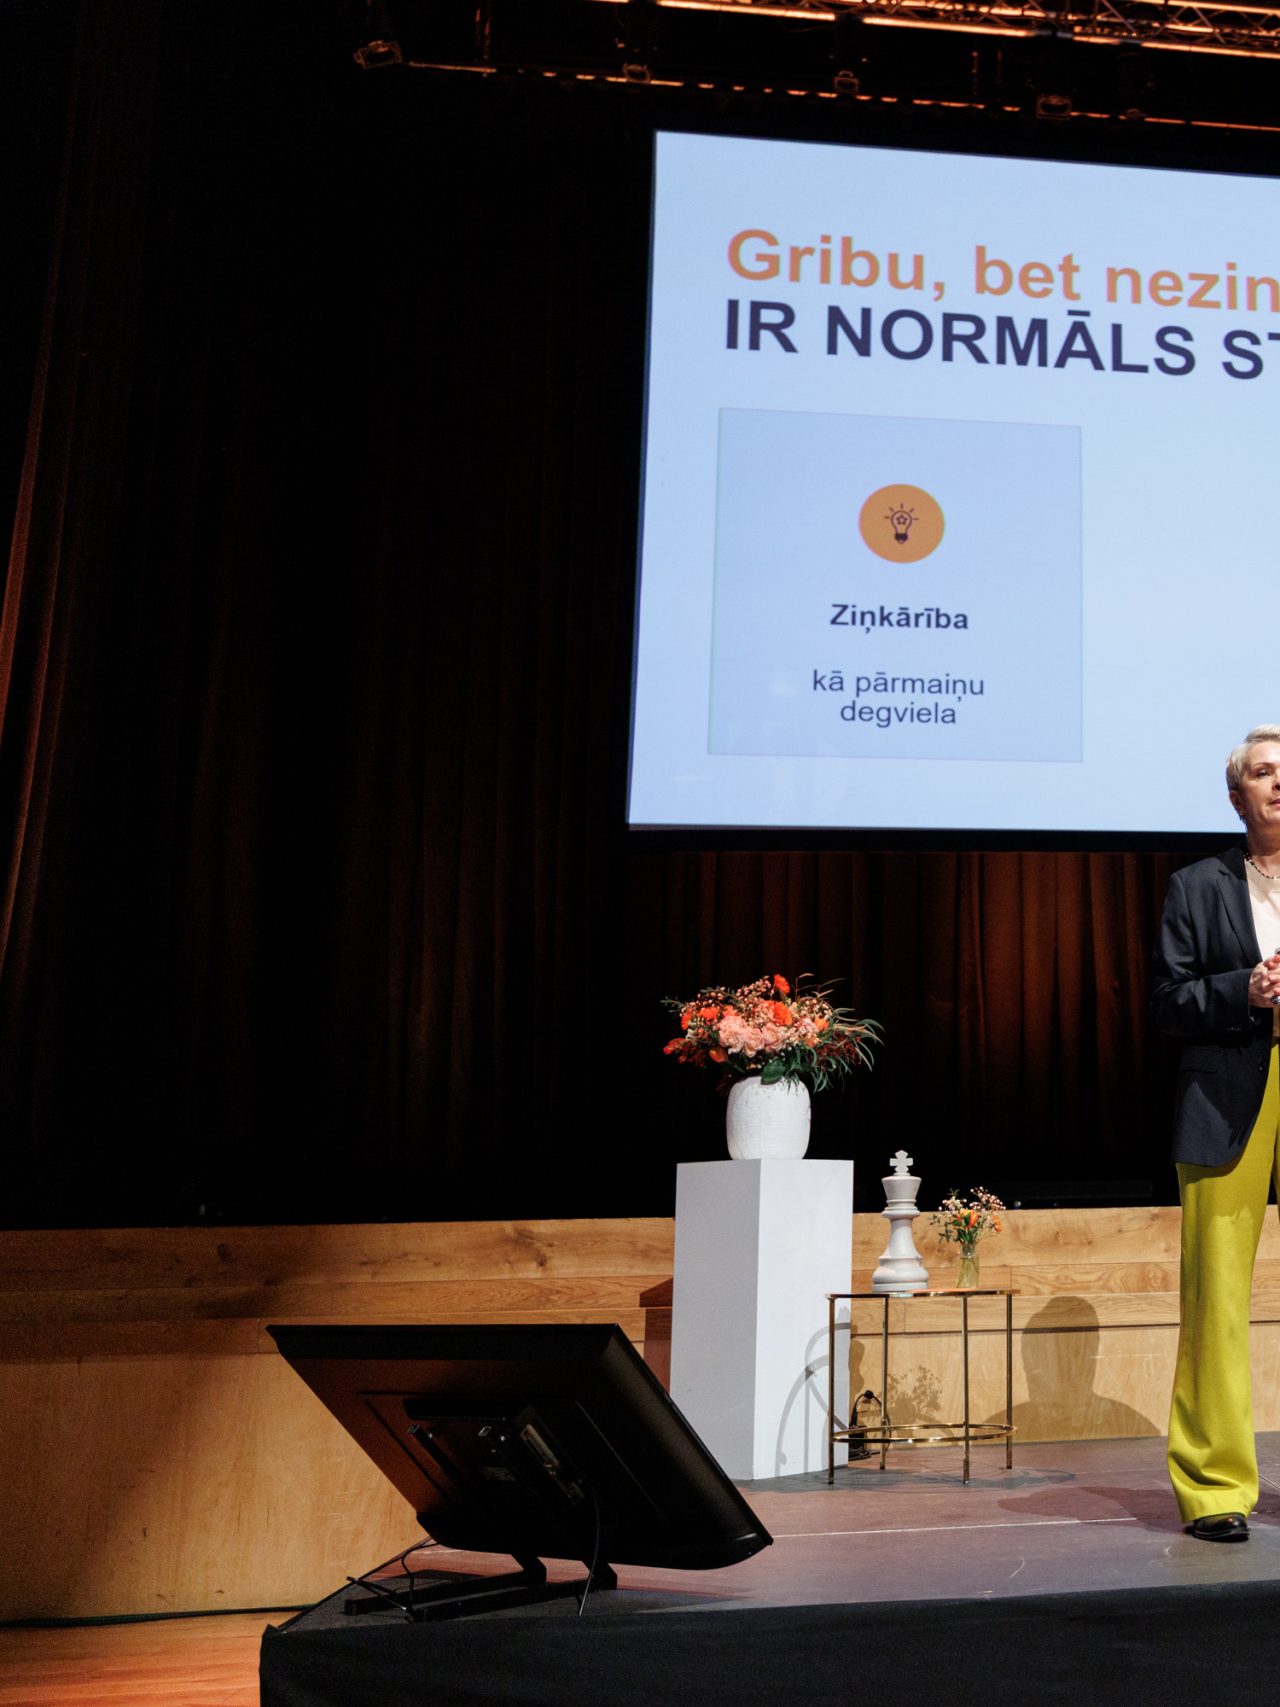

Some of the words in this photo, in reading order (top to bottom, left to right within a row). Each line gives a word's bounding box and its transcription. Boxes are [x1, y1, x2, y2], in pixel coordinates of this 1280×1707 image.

[727, 228, 946, 302] Gribu,
[974, 243, 1082, 302] bet
[726, 299, 798, 353] IR
[827, 305, 1196, 376] NORMĀLS
[829, 604, 969, 633] Ziņkārība
[812, 669, 845, 692] kā
[855, 671, 985, 702] pārmaiņu
[840, 700, 957, 728] degviela
